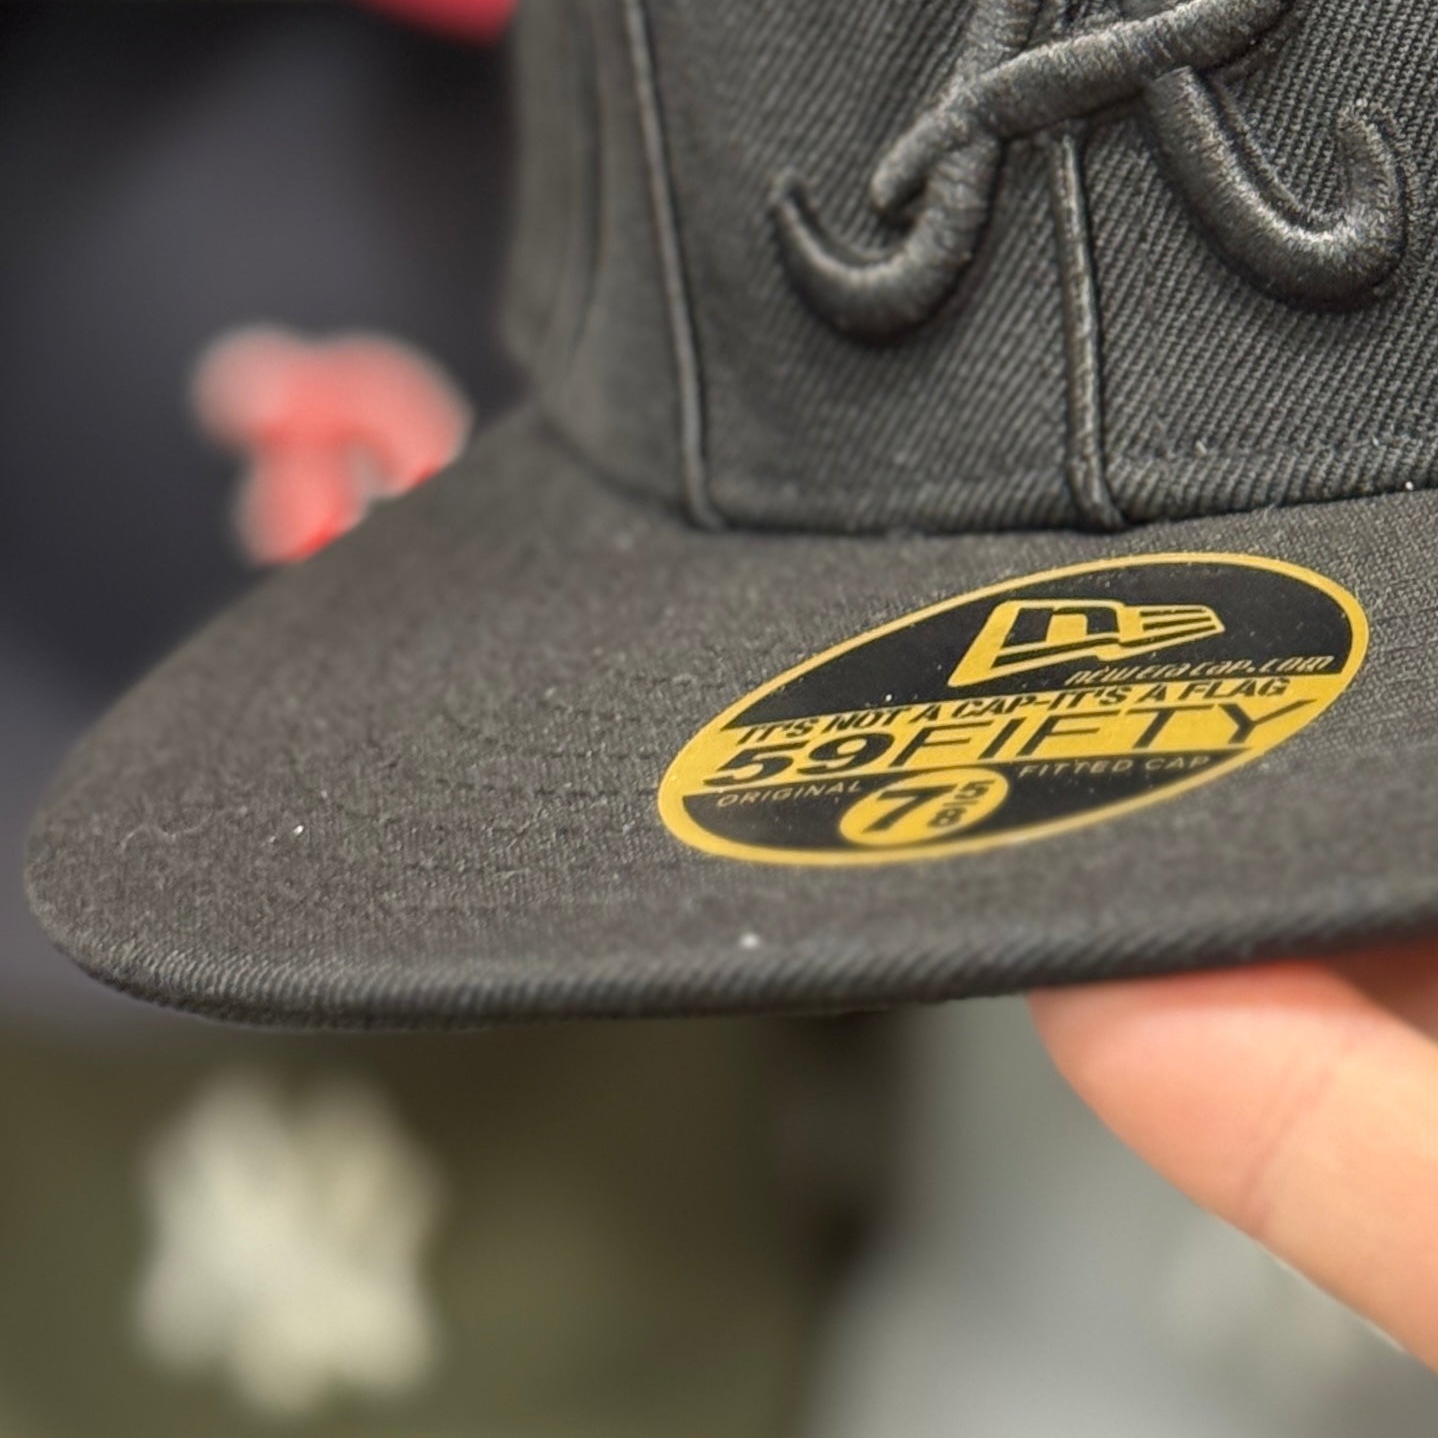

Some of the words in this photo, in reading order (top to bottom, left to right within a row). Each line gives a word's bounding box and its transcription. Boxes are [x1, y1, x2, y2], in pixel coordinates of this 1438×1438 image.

[736, 718, 819, 745] IT'S
[821, 707, 911, 734] NOT
[907, 704, 941, 725] A
[1134, 680, 1169, 704] A
[1178, 677, 1291, 701] FLAG
[703, 698, 1318, 786] 59FIFTY
[1018, 758, 1134, 778] FITTED
[1145, 755, 1211, 771] CAP
[716, 780, 863, 808] ORIGINAL
